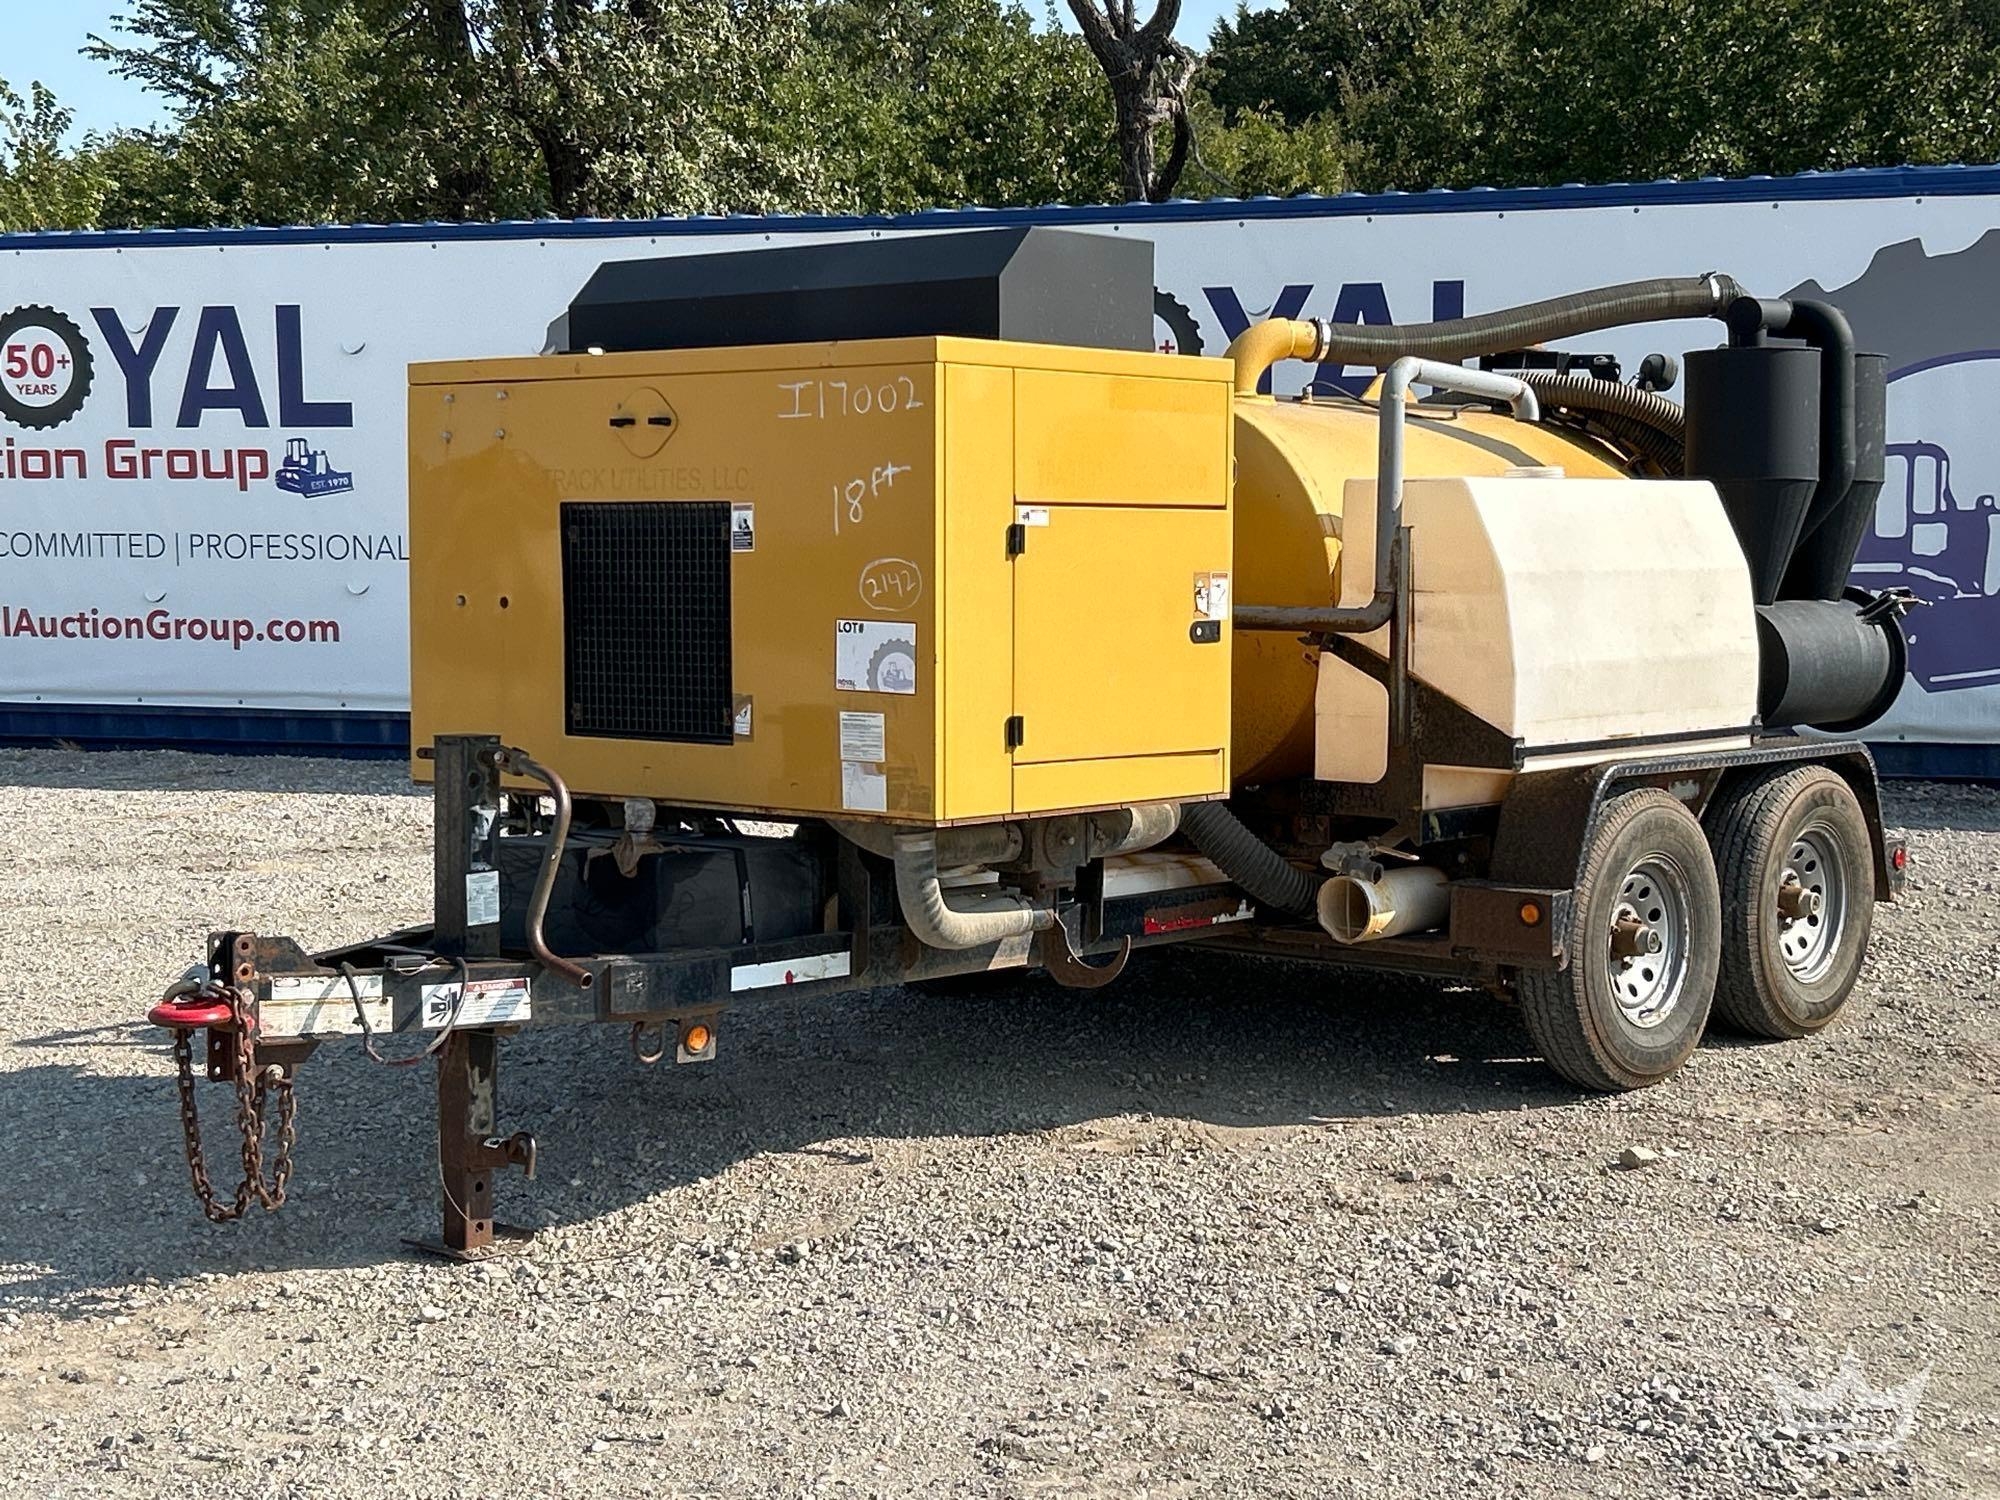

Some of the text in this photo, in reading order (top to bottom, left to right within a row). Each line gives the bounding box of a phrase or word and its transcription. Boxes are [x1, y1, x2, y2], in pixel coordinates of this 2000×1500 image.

[6, 344, 71, 379] 50+
[16, 383, 57, 396] YEARS
[0, 437, 269, 491] ion Group
[328, 477, 349, 487] 1970
[543, 468, 606, 492] TRACK
[190, 533, 409, 561] PROFESSIONAL
[865, 570, 916, 598] 2142
